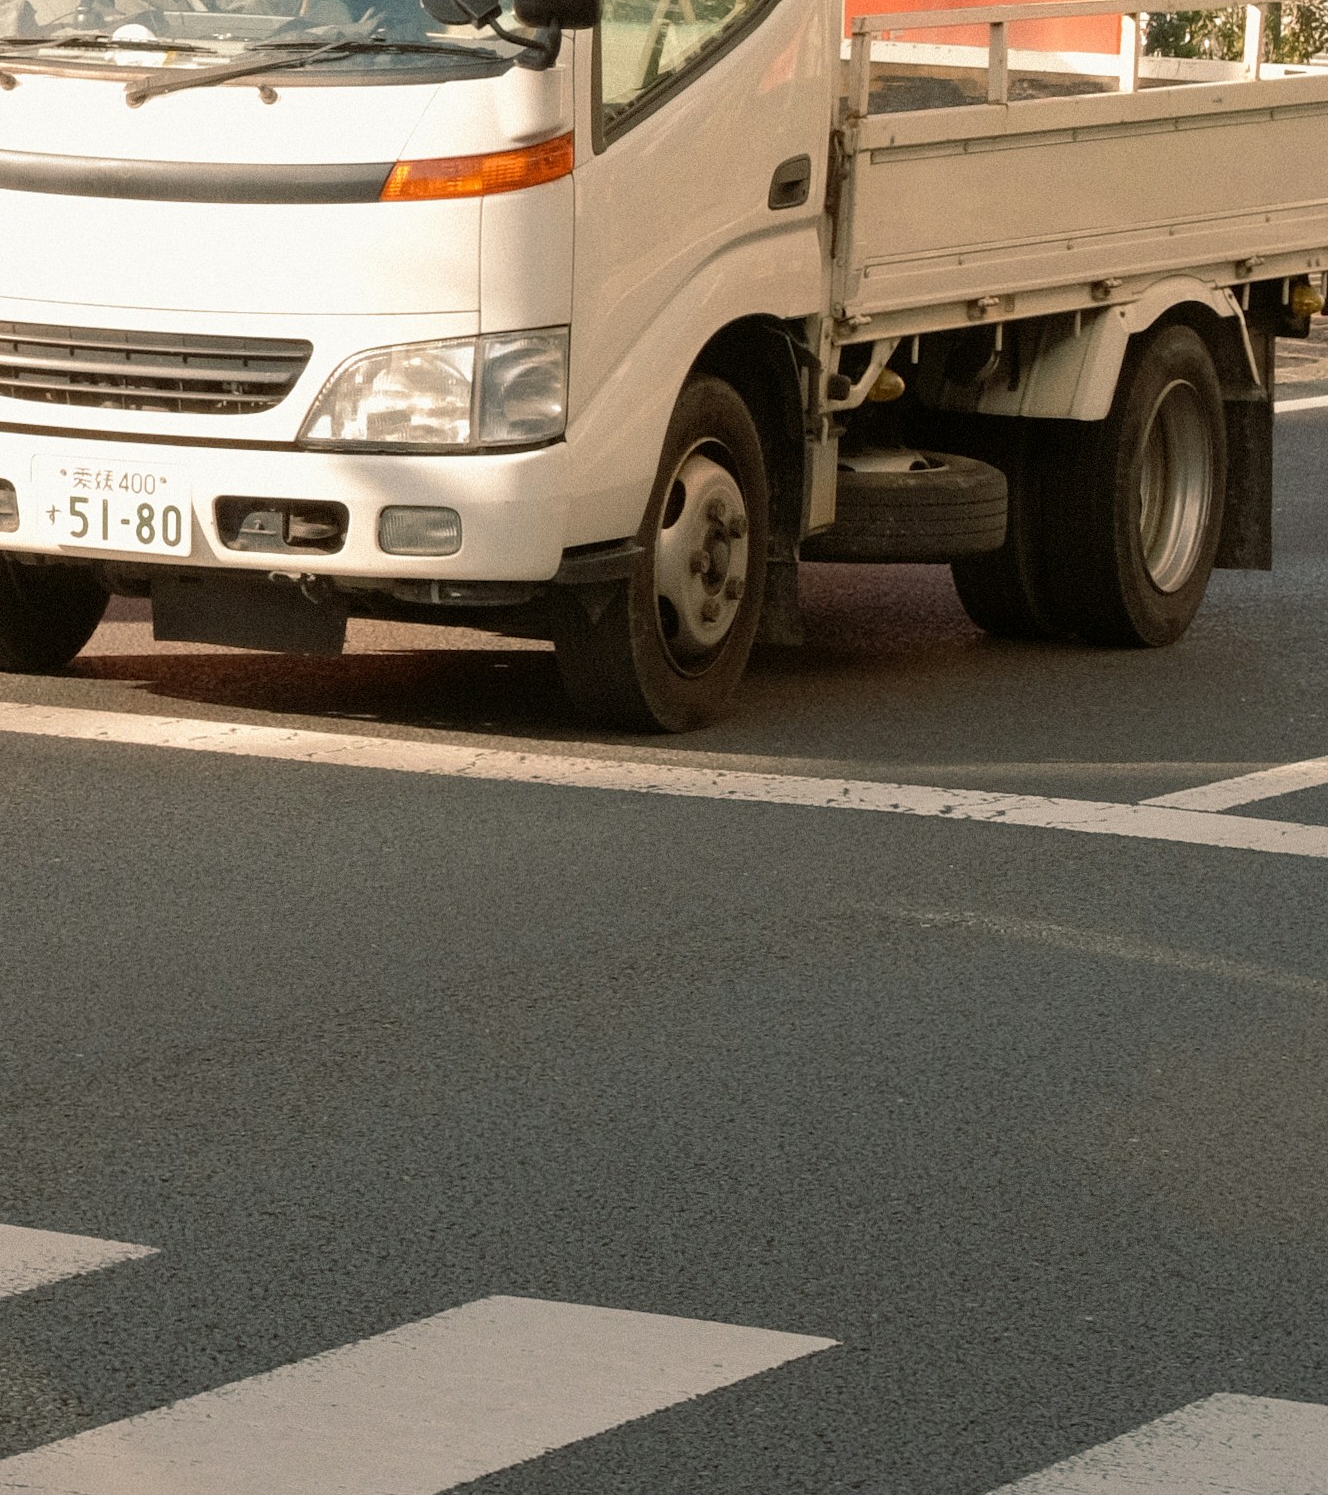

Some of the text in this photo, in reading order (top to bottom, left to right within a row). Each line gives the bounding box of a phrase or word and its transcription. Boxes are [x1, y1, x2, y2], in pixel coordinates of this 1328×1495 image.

[118, 472, 156, 495] 400
[46, 495, 182, 548] す 51-80
